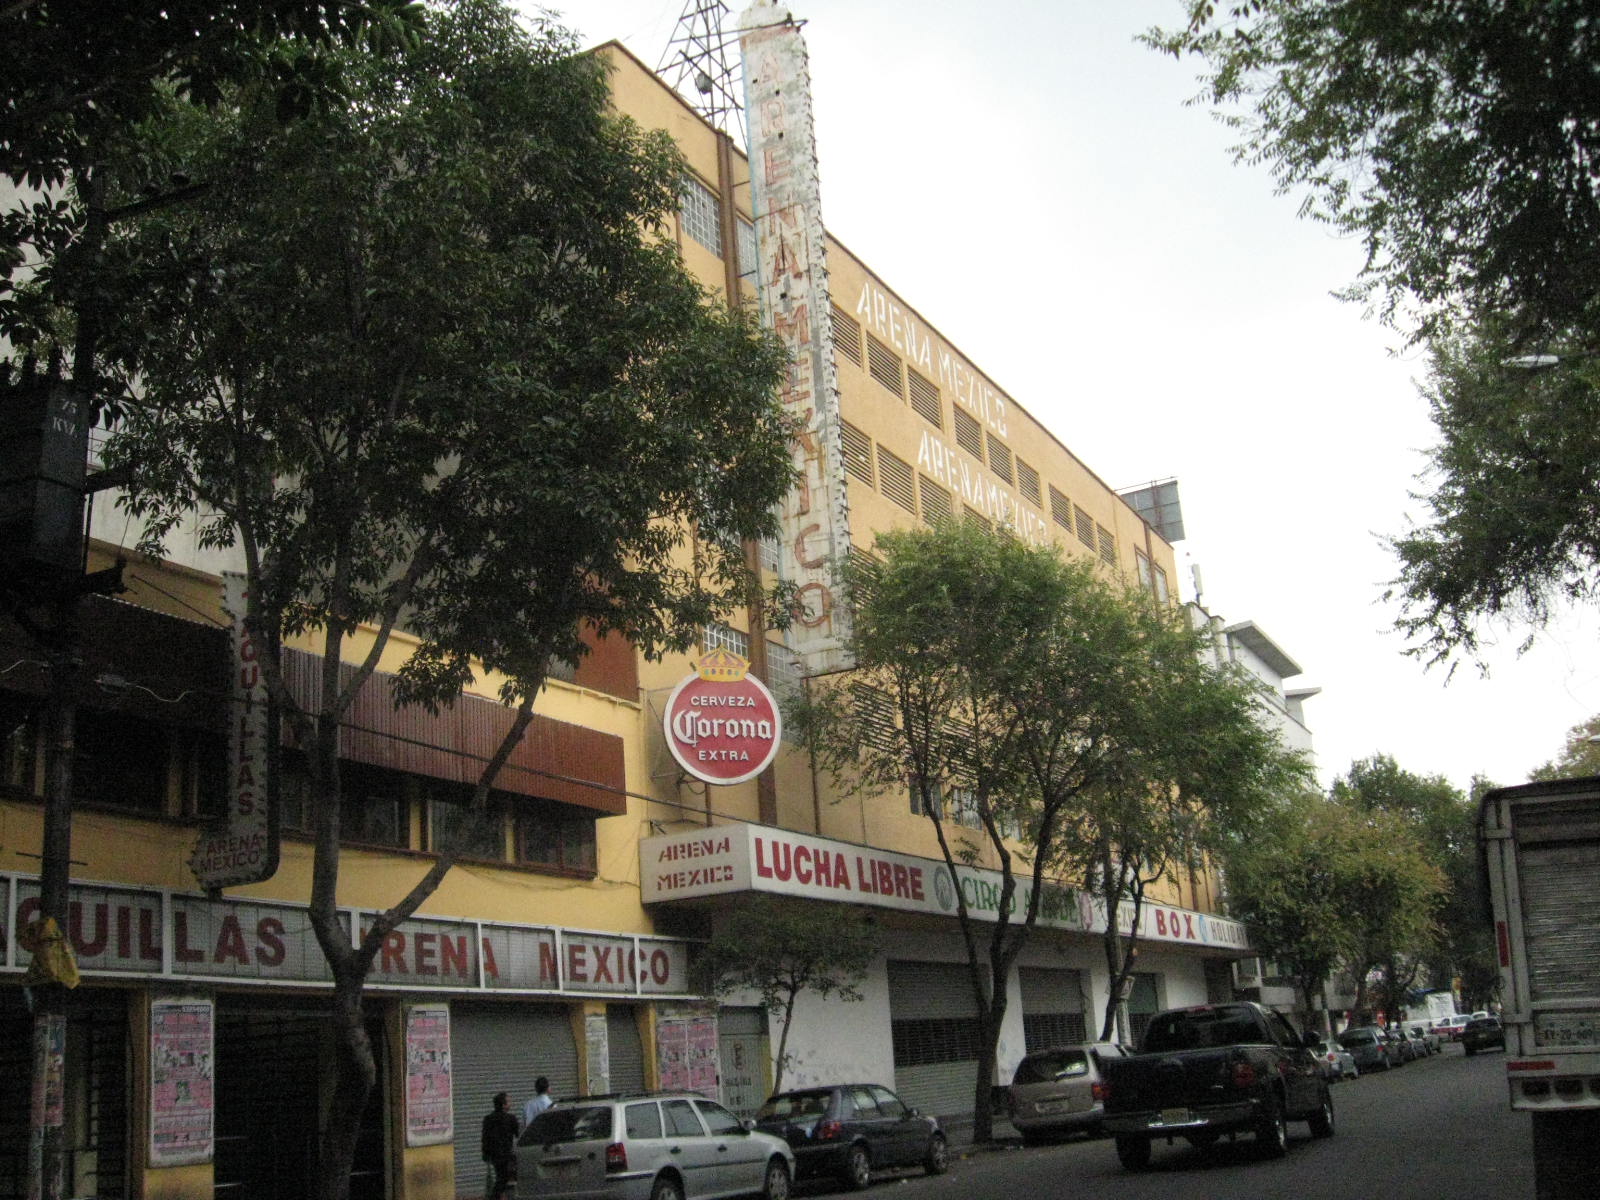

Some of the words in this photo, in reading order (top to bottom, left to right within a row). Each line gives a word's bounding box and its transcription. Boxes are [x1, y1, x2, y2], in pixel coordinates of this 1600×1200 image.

[757, 51, 804, 288] ARENA
[857, 281, 933, 373] ARENA
[937, 345, 1008, 438] MEXICO
[918, 430, 984, 509] ARENA
[986, 479, 1047, 548] MEXICO
[239, 590, 258, 815] QUILLAS
[690, 695, 756, 707] CERVEZA
[672, 709, 773, 747] Corona
[698, 750, 750, 762] EXTRA
[199, 849, 260, 873] MEXICO
[206, 834, 262, 855] ARENA
[658, 837, 731, 863] ARENA
[657, 864, 734, 891] MEXICO
[755, 837, 852, 891] LUCHA
[856, 856, 925, 901] LIBRE
[1155, 909, 1196, 940] BOX
[539, 941, 670, 986] MEXICO
